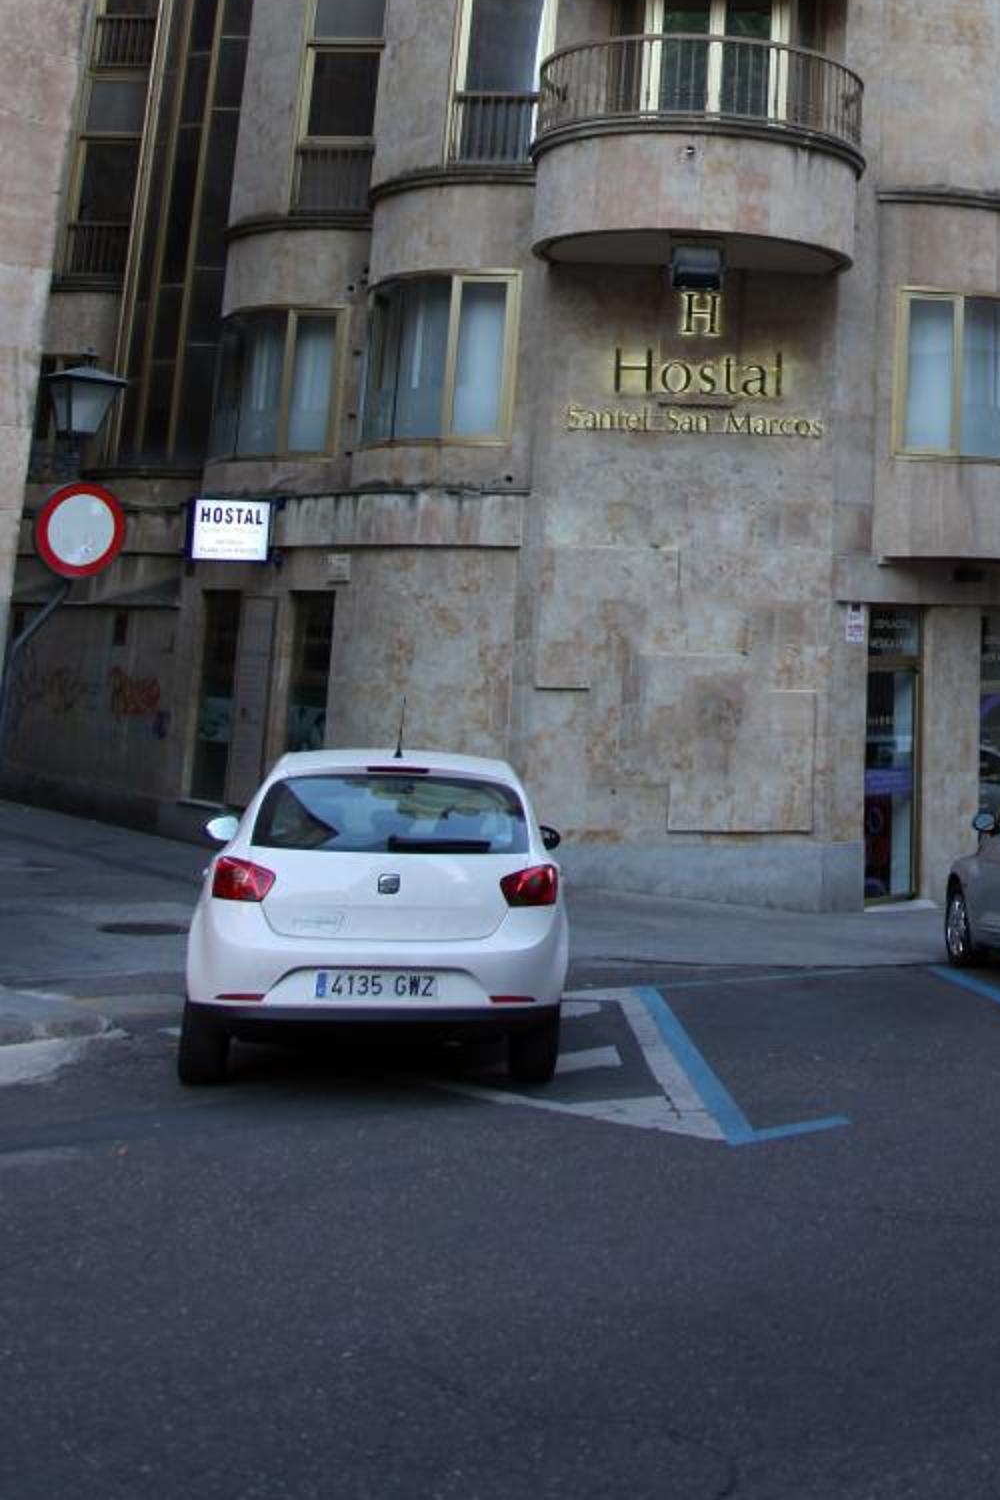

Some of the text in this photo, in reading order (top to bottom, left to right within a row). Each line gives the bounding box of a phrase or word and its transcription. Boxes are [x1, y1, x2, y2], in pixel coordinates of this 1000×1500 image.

[678, 291, 721, 336] H
[613, 347, 783, 397] Hostal
[567, 403, 824, 438] Santel San Marcos
[201, 506, 263, 525] HOSTAL
[331, 974, 436, 997] 4135 GWZ
